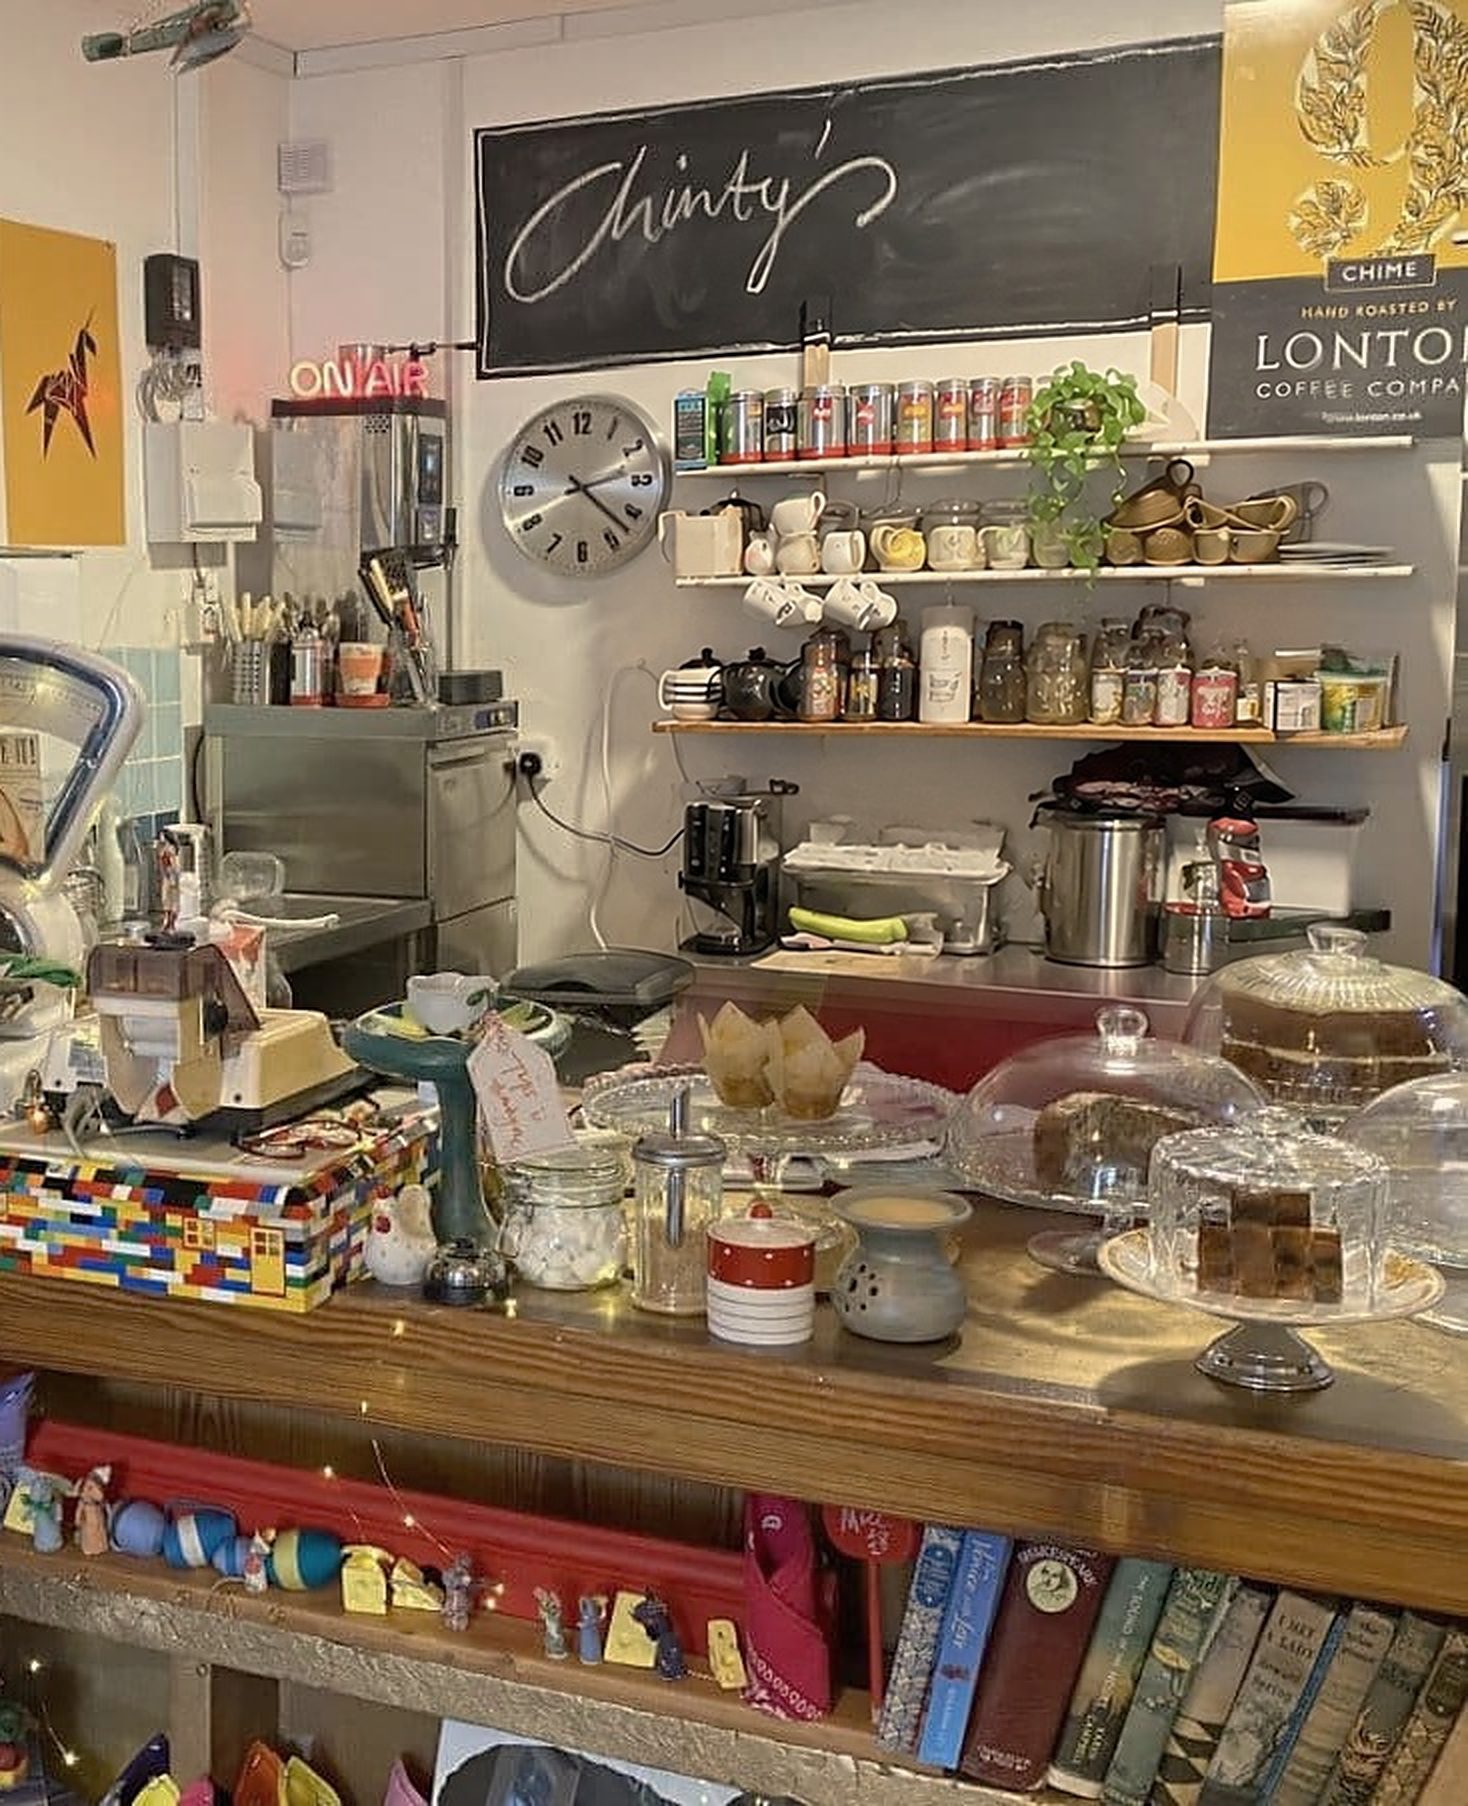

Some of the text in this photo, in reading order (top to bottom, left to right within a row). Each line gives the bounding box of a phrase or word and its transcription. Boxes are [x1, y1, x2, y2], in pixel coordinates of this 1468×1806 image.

[1341, 261, 1418, 282] CHIME
[1302, 297, 1458, 320] HAND ROASTED BY
[1255, 325, 1468, 371] LONTO
[290, 360, 430, 399] ON AIR
[1255, 379, 1354, 400] COFFEE
[543, 420, 564, 447] 11
[572, 411, 593, 436] 12
[521, 445, 545, 469] 10
[546, 532, 563, 555] 7
